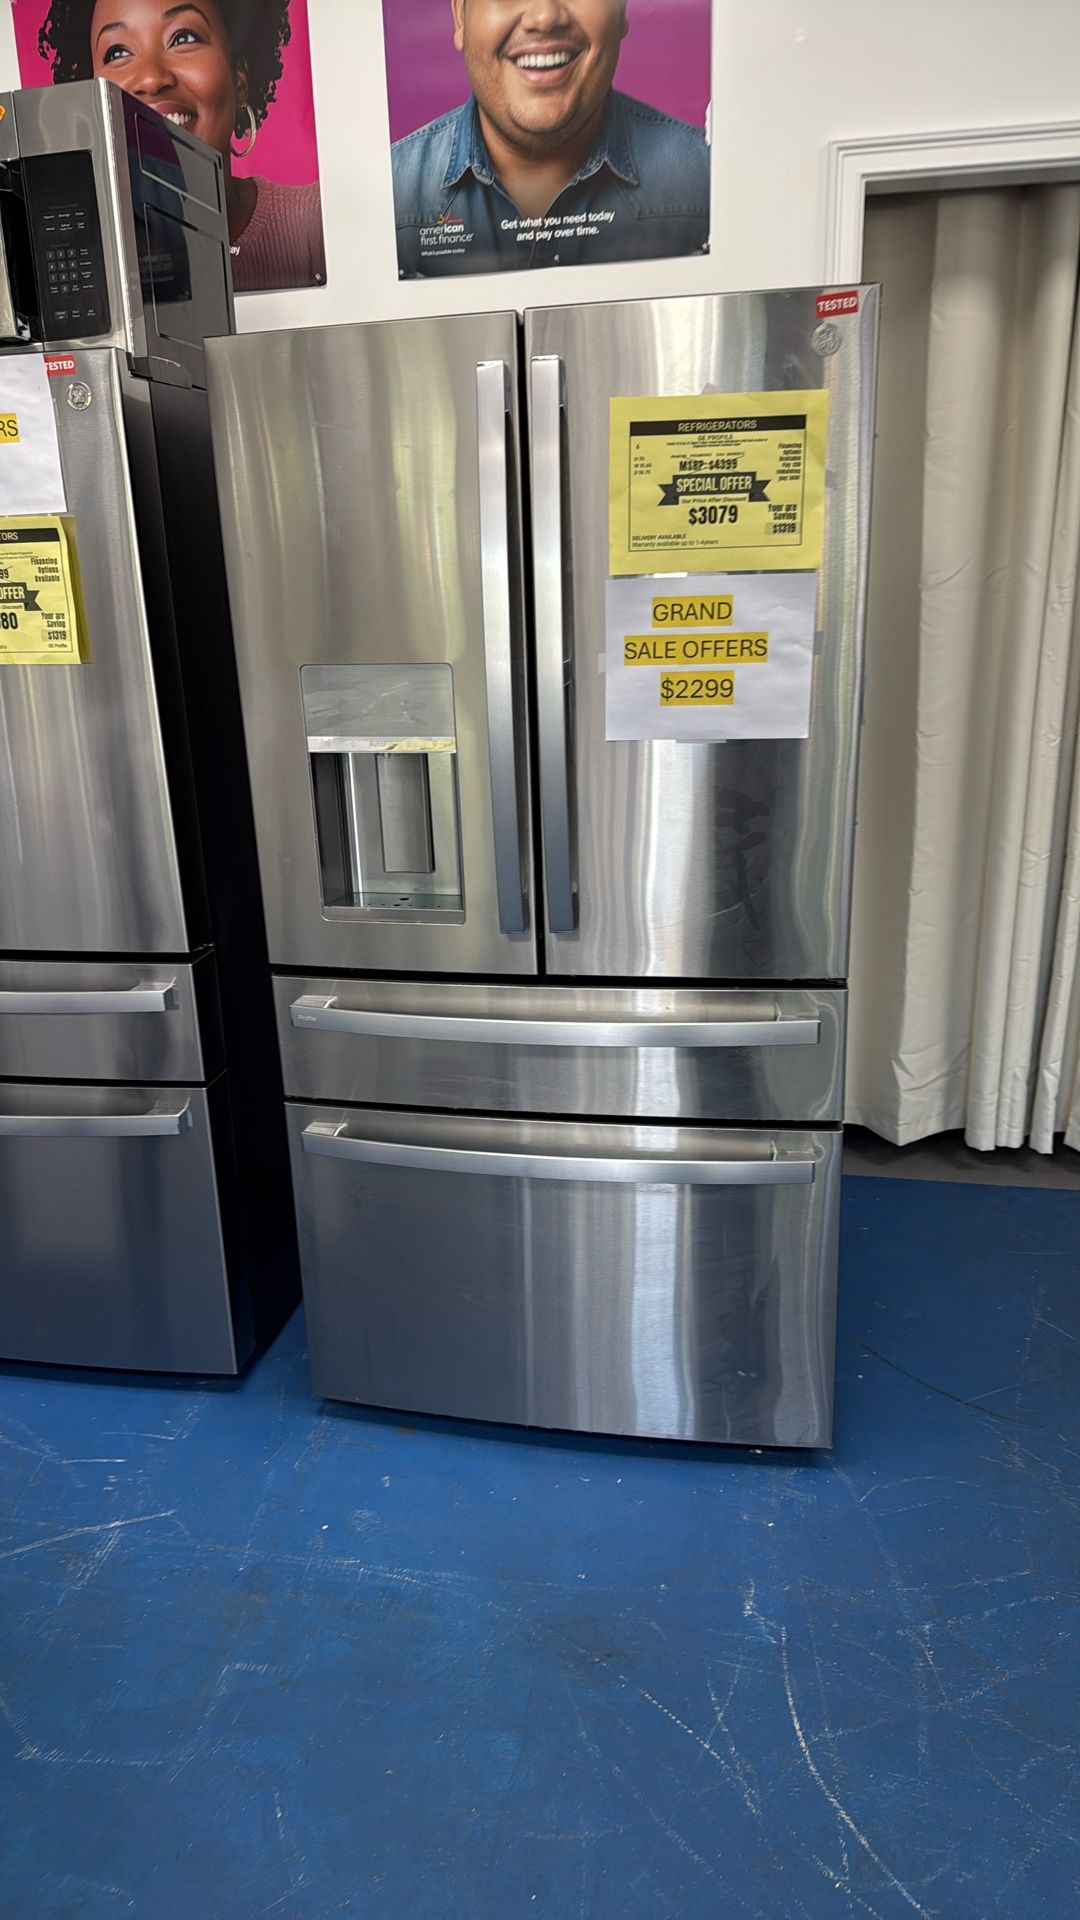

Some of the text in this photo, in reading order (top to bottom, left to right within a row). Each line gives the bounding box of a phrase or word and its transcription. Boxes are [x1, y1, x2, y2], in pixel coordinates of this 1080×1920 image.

[500, 210, 616, 230] Get what you need today
[420, 224, 465, 236] american
[516, 225, 600, 241] and pay over time.
[420, 235, 438, 246] first
[817, 296, 858, 312] TESTED
[678, 420, 758, 432] REFRIGERATORS
[676, 476, 752, 492] SPECIAL OFFER
[688, 505, 738, 526] $3079
[0, 531, 18, 541] ORS
[31, 557, 58, 566] Financing
[38, 566, 59, 574] Options
[652, 602, 733, 622] GRAND
[47, 620, 66, 628] Saving
[48, 630, 67, 641] $1319
[624, 638, 768, 660] SALE OFFERS
[660, 677, 734, 702] $2299
